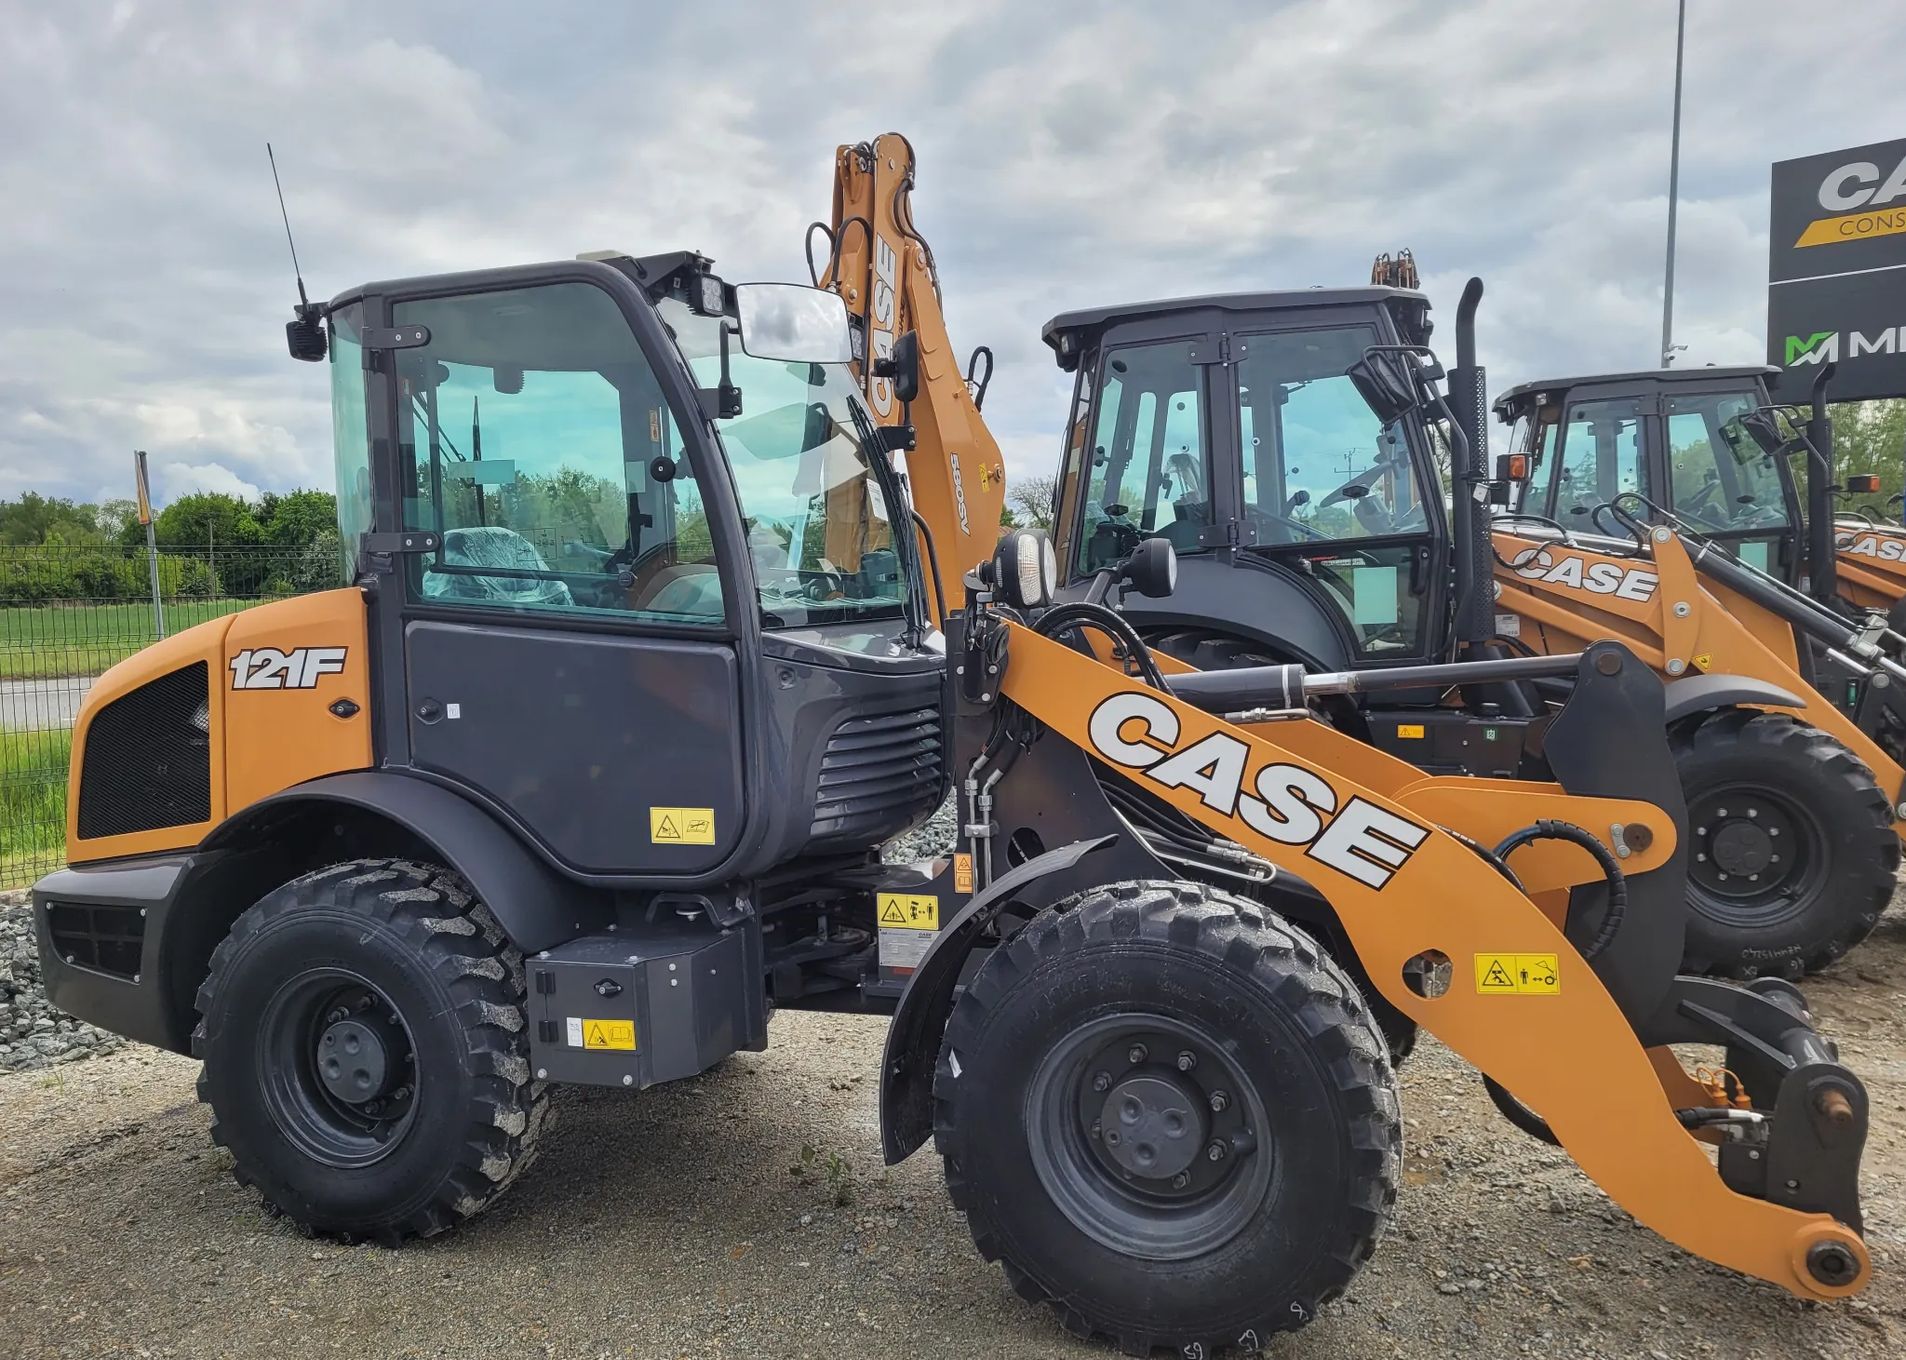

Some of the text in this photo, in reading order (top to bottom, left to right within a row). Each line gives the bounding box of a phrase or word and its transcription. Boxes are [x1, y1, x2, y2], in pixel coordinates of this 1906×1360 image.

[1839, 212, 1906, 236] CONS
[870, 232, 896, 418] CASE
[950, 452, 971, 538] 580SV
[1835, 532, 1906, 563] CAS
[1512, 548, 1660, 603] CASE
[228, 646, 349, 691] 121F
[1088, 691, 1433, 892] CASE
